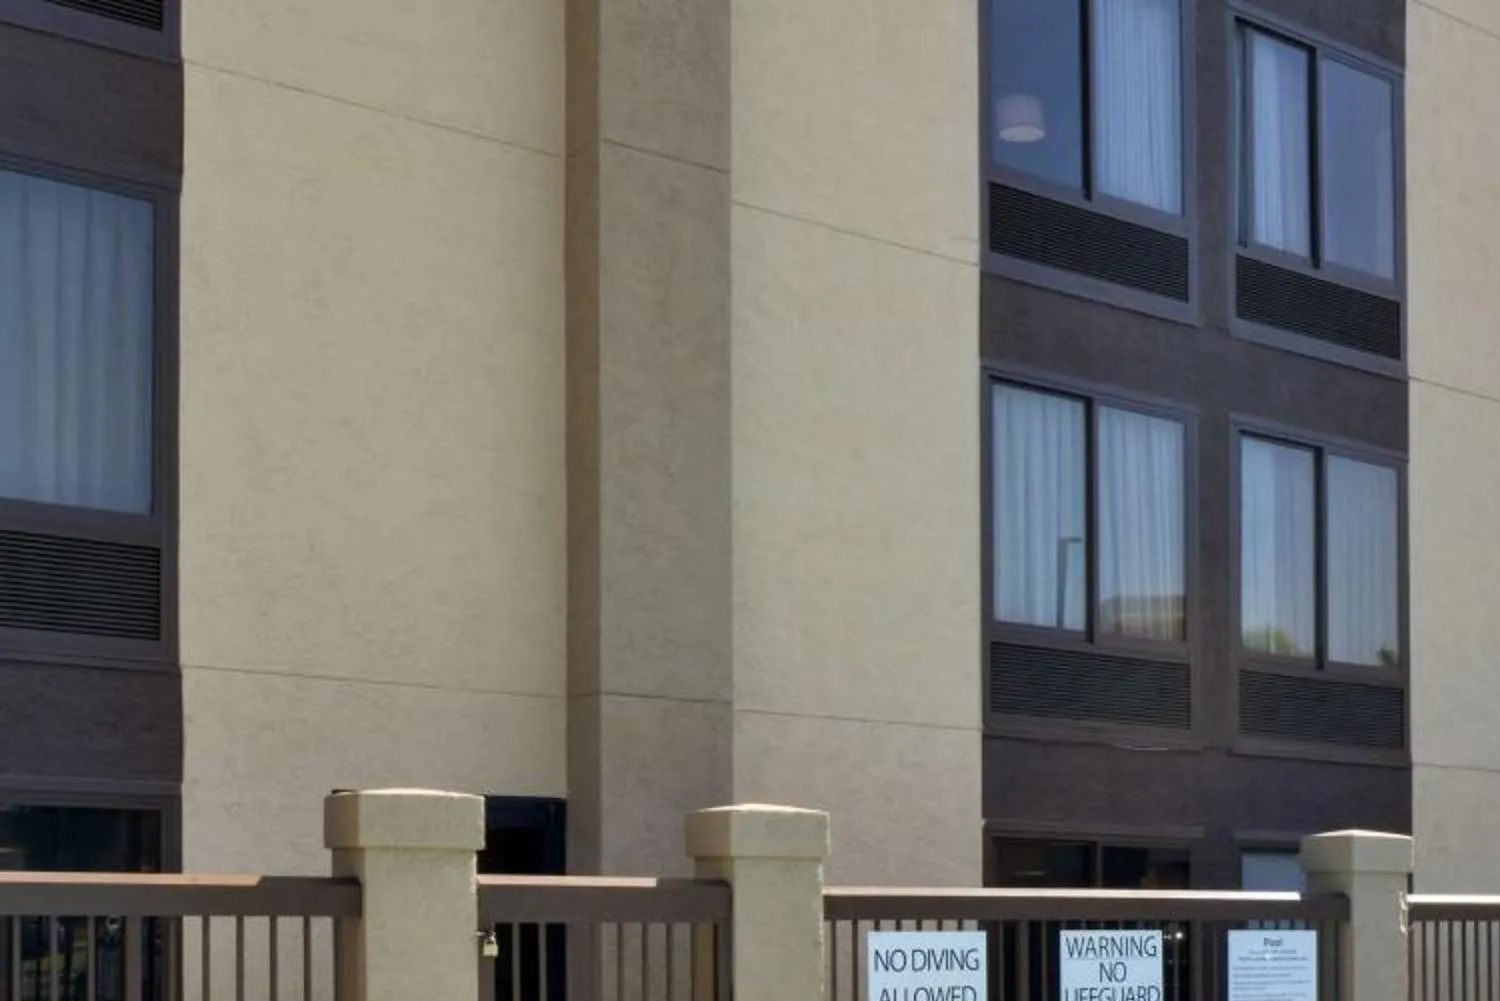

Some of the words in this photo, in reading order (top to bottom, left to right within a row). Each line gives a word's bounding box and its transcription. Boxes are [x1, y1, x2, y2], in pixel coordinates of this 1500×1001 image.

[1065, 935, 1158, 958] WARNING
[874, 948, 908, 973] NO
[911, 947, 980, 972] DIVING
[1099, 961, 1128, 983] NO
